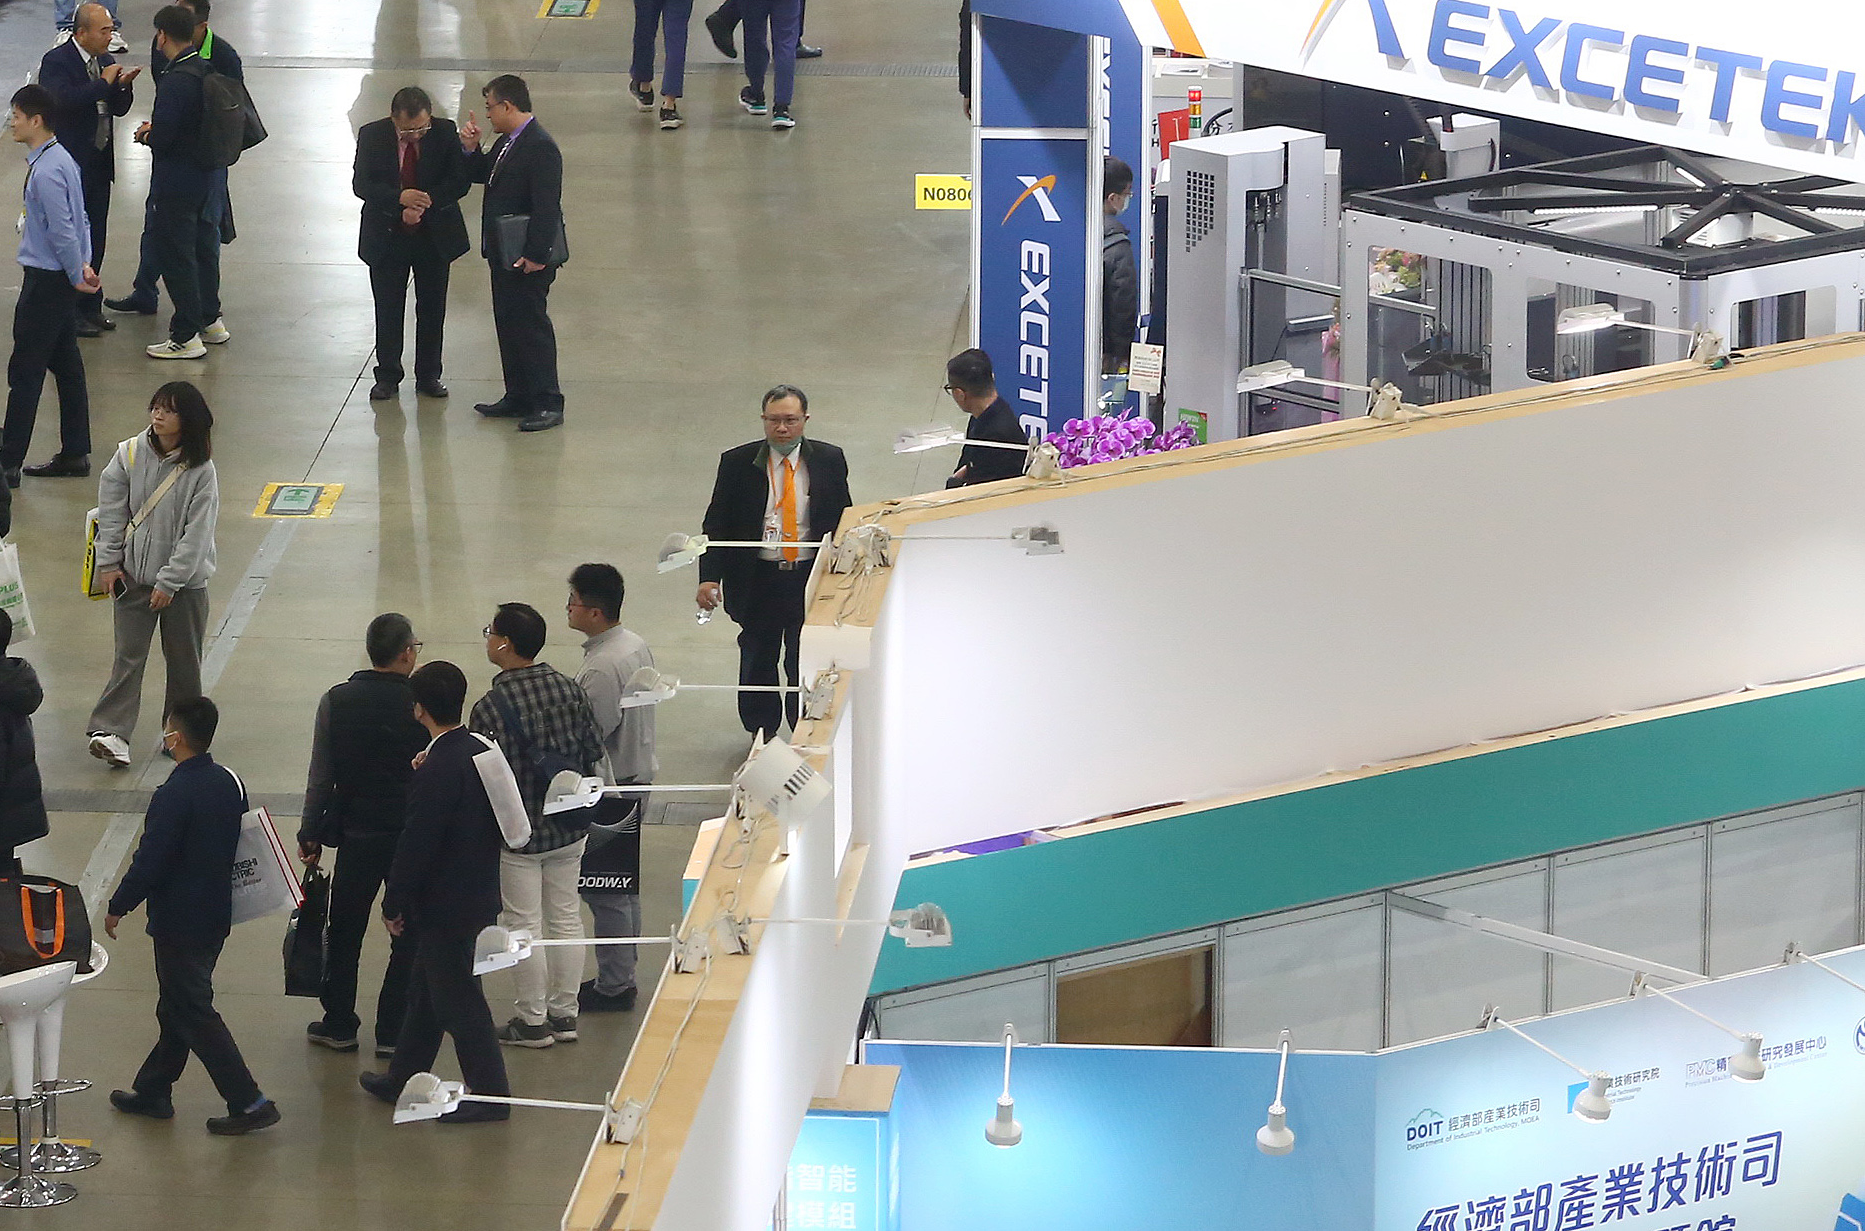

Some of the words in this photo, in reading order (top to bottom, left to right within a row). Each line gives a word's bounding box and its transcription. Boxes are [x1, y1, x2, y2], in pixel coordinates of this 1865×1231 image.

[578, 875, 633, 890] OODWAY
[1447, 1098, 1541, 1132] 經濟部產業技術司
[1406, 1120, 1444, 1142] DOIT
[1406, 1138, 1445, 1152] Department
[1445, 1135, 1453, 1143] of
[1453, 1128, 1483, 1141] Industrial
